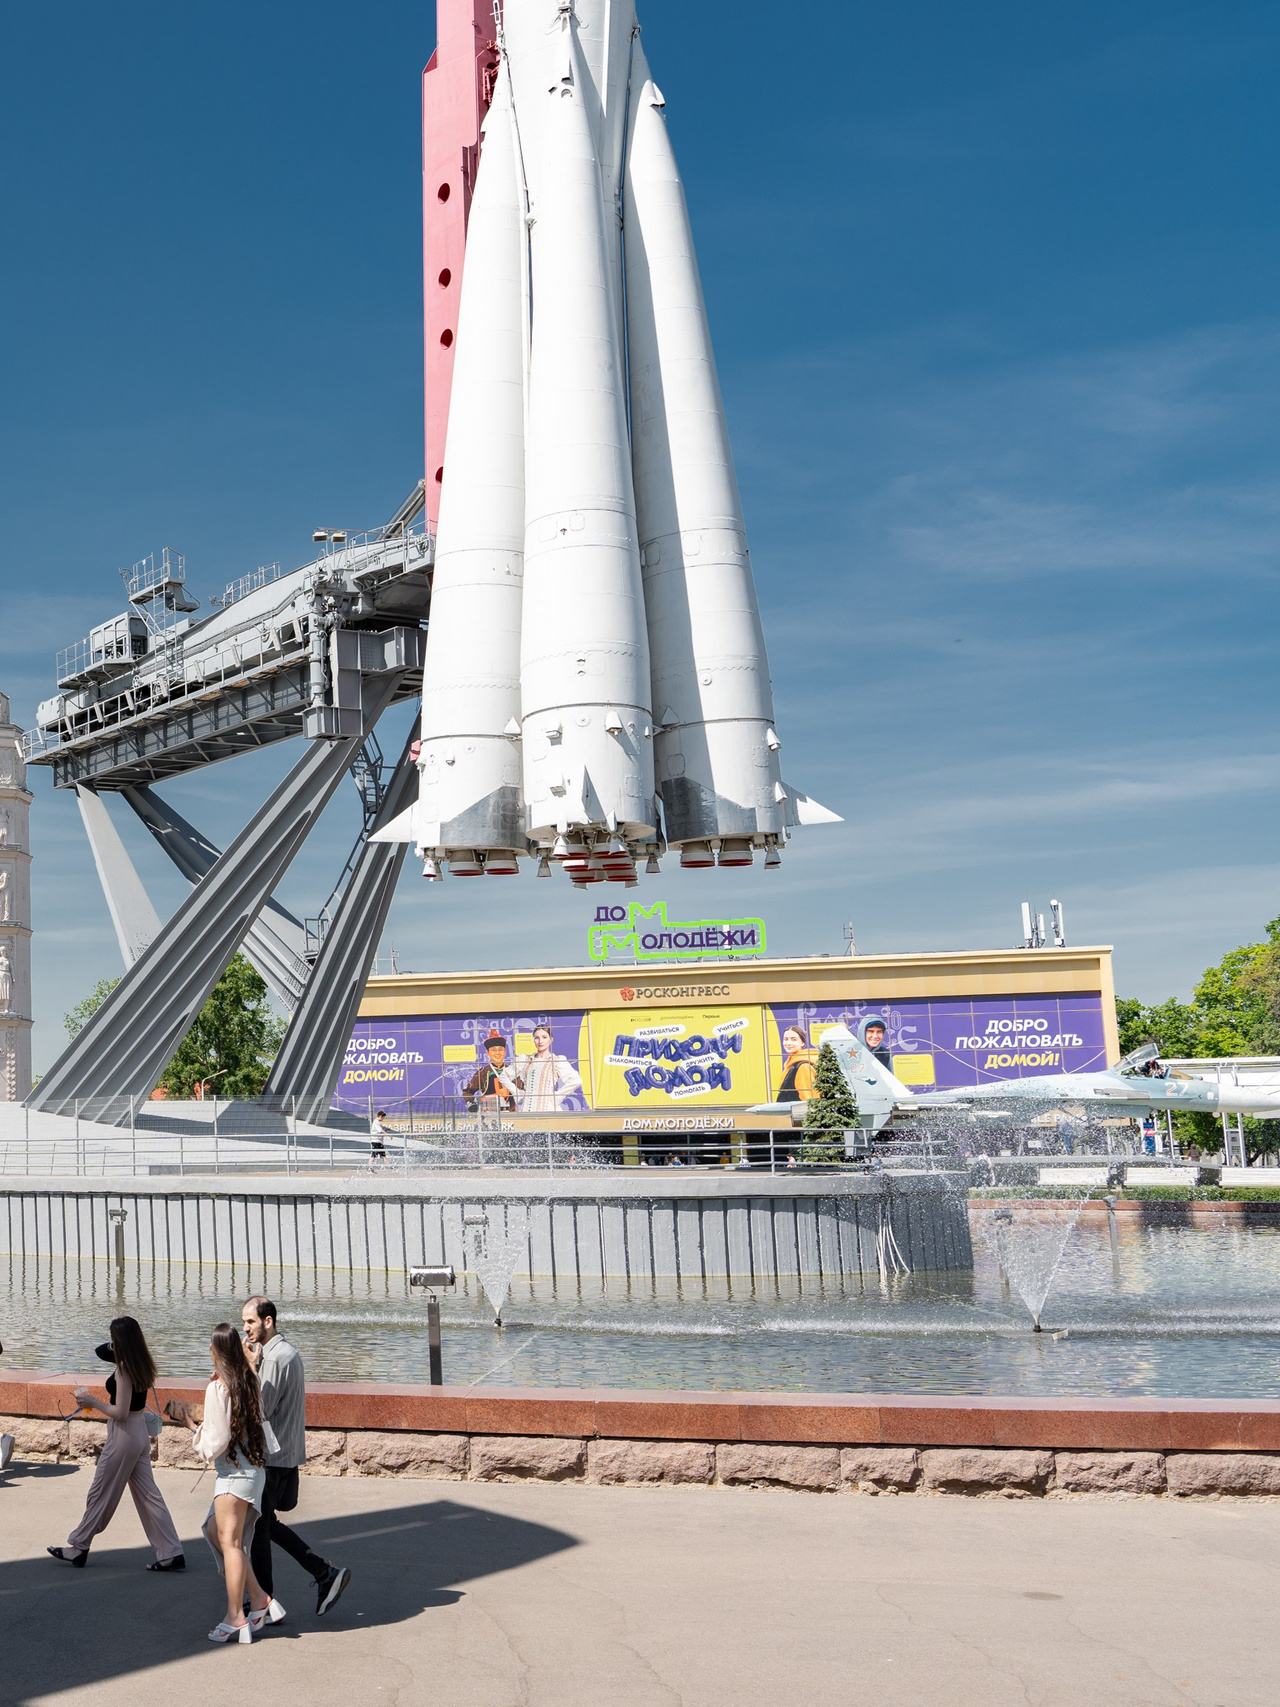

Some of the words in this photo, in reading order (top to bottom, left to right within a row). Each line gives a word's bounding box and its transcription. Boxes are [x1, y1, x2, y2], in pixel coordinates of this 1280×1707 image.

[636, 985, 730, 998] РОСКОНГРЕСС
[639, 1026, 680, 1036] РАЗВИВАТЬСЯ
[716, 1020, 744, 1033] УЧИТЬСЯ
[985, 1018, 1049, 1035] ДОБРО
[346, 1037, 397, 1052] ДОБРО
[613, 1032, 743, 1062] ПРИХОДИ
[955, 1033, 1083, 1049] ПОЖАЛОВАТЬ
[342, 1051, 424, 1065] ЖАЛОВАТЬ
[608, 1056, 653, 1067] ЗНАКОМИТЬСЯ
[685, 1055, 715, 1068] ДРУЖИТЬ
[984, 1050, 1060, 1070] ДОМОЙ!
[342, 1067, 405, 1085] ДОМОЙ!
[849, 1063, 866, 1074] 27
[624, 1062, 732, 1097] ДОМОЙ
[674, 1085, 706, 1097] ПОМОГАТЬ
[1164, 1081, 1190, 1097] 27
[622, 1117, 652, 1130] ДОМ
[656, 1115, 735, 1130] МОЛОДЁЖИ
